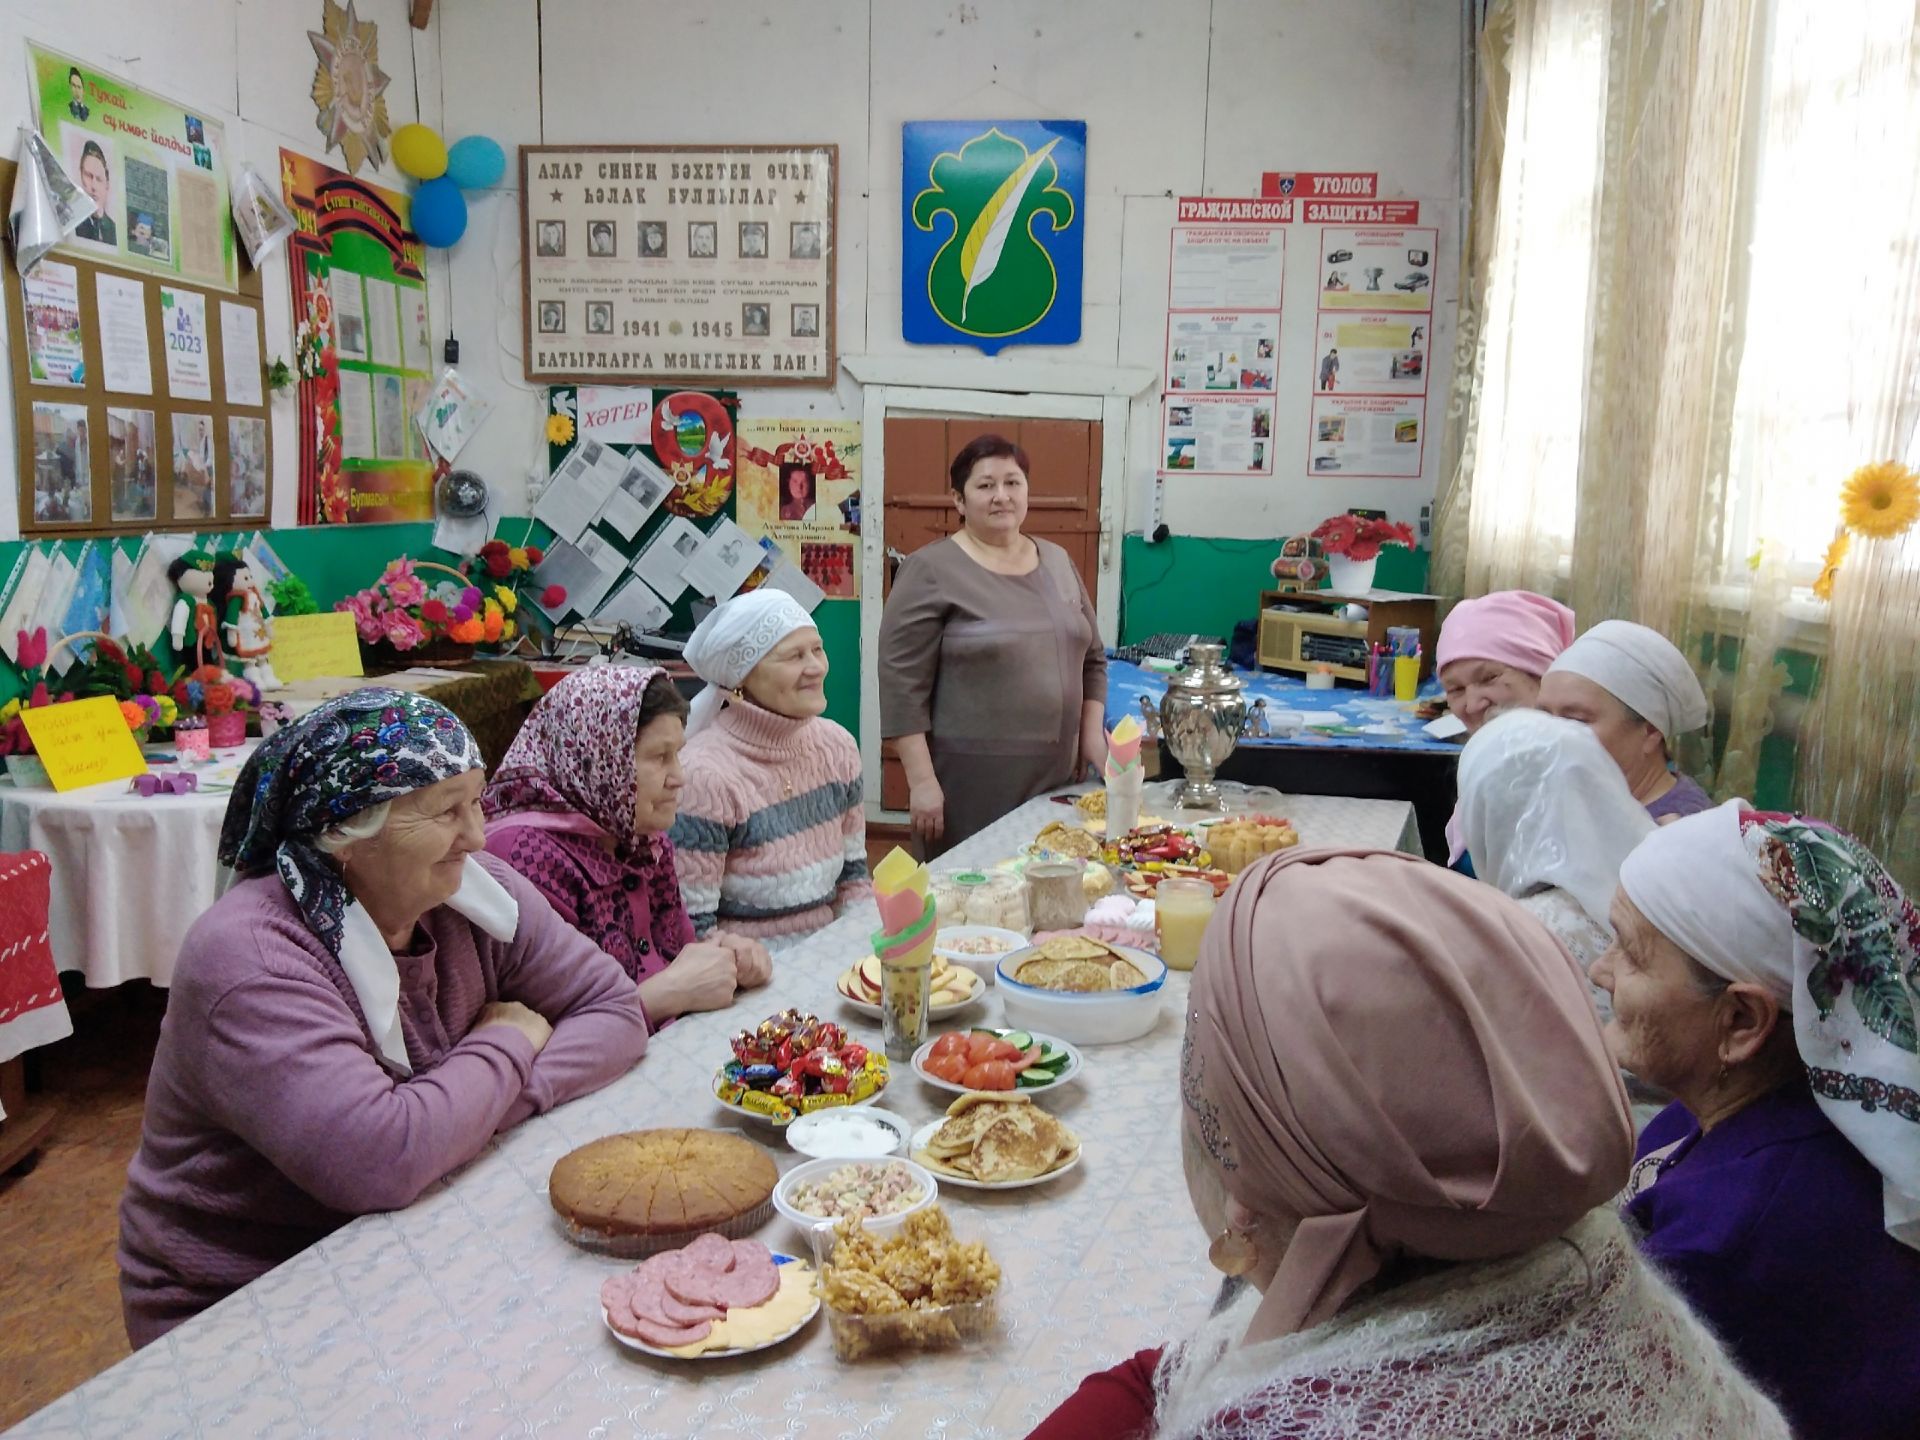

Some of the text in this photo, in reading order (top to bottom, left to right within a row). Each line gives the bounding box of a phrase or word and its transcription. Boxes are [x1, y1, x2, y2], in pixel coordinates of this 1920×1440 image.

[538, 162, 583, 179] АЛАР
[598, 162, 657, 180] СИНЕҢ
[1313, 176, 1373, 194] УГОЛОК
[668, 187, 777, 205] БУЛДЫЛАР
[1179, 199, 1293, 221] ГРАЖДАНСКОЙ
[1308, 204, 1384, 223] ЗАЩИТЫ
[297, 208, 318, 237] 1941
[622, 320, 733, 337] 1941 1945
[169, 332, 202, 354] 2023
[538, 351, 654, 368] БАТЫРЛАРГА
[664, 352, 762, 370] МӘҢГЕЛЕК
[584, 401, 649, 429] ХӘТЕР
